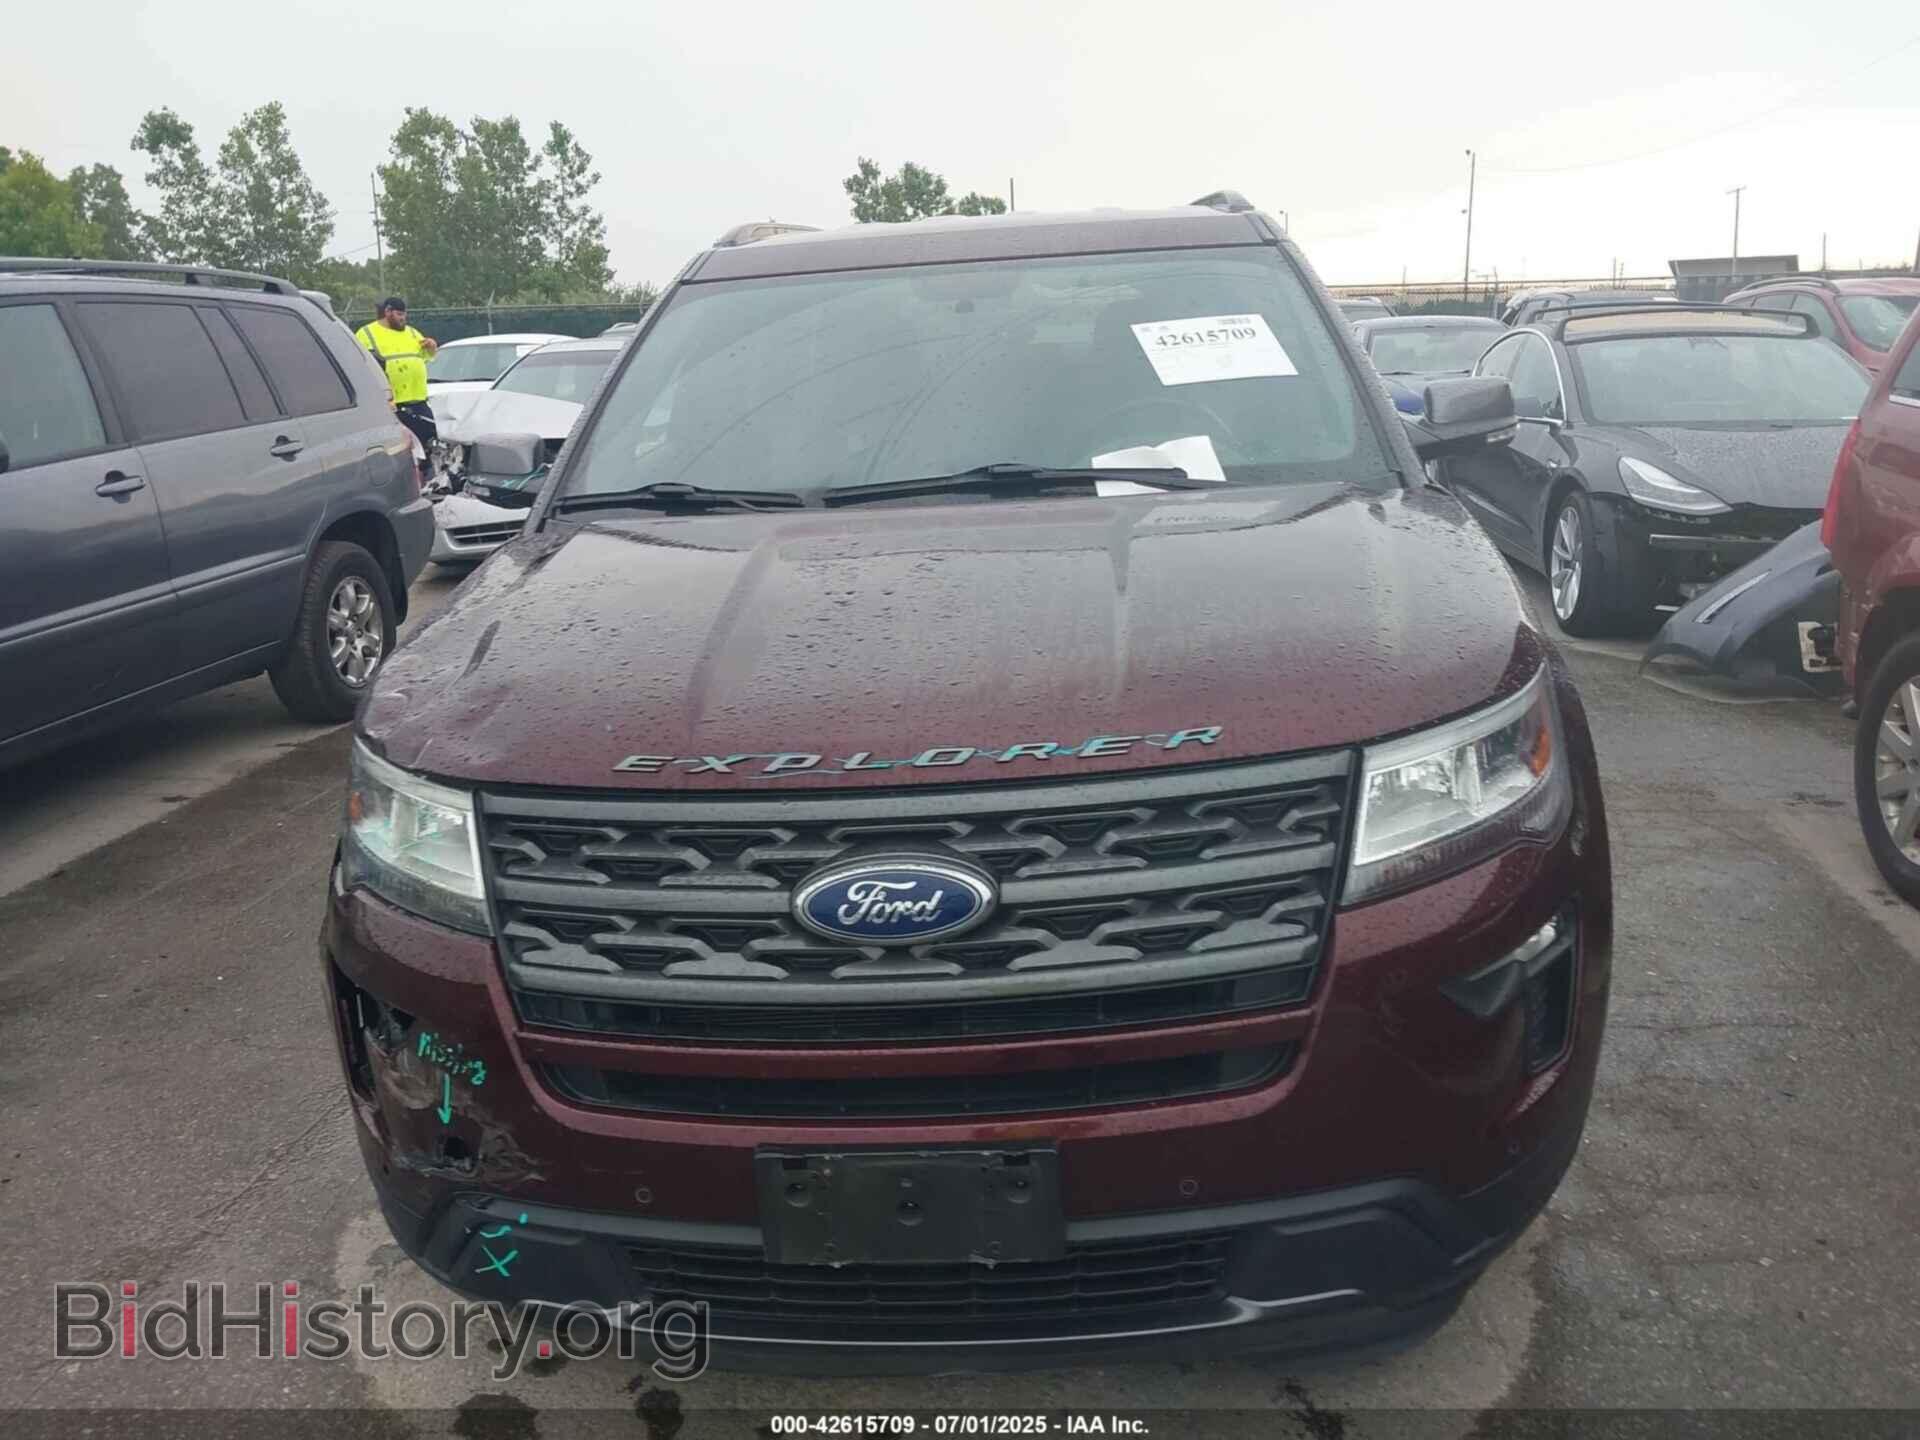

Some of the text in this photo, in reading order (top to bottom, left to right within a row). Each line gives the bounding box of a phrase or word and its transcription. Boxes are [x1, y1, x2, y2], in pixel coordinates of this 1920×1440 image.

[1155, 327, 1257, 347] 42615709
[612, 725, 1224, 774] EXPLORER
[836, 880, 945, 926] Ford
